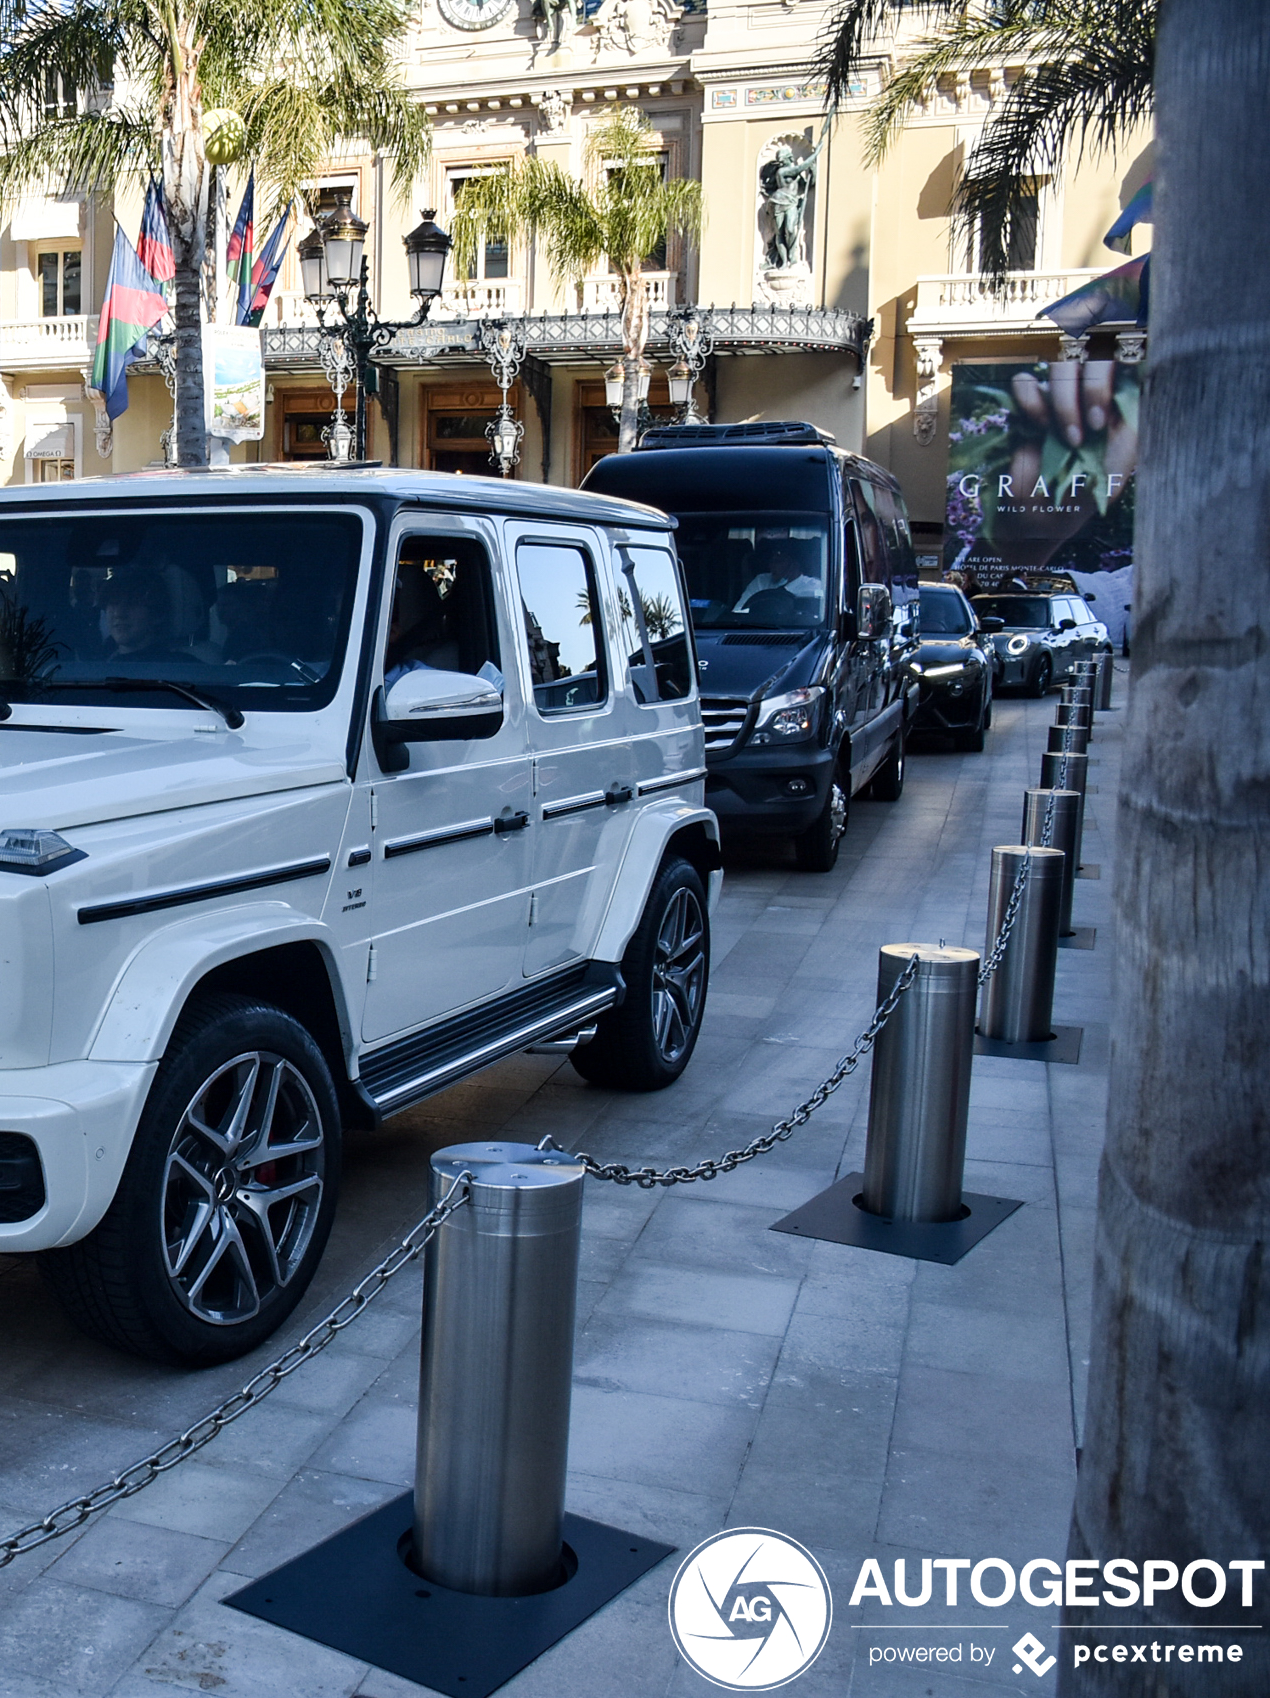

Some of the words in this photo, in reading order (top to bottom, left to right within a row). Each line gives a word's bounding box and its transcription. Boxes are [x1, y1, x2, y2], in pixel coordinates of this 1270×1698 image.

[397, 328, 446, 338] CASINO
[959, 474, 1123, 498] GRAFF
[997, 505, 1025, 513] WILD
[1032, 505, 1080, 513] FLOWER
[347, 888, 362, 899] V8
